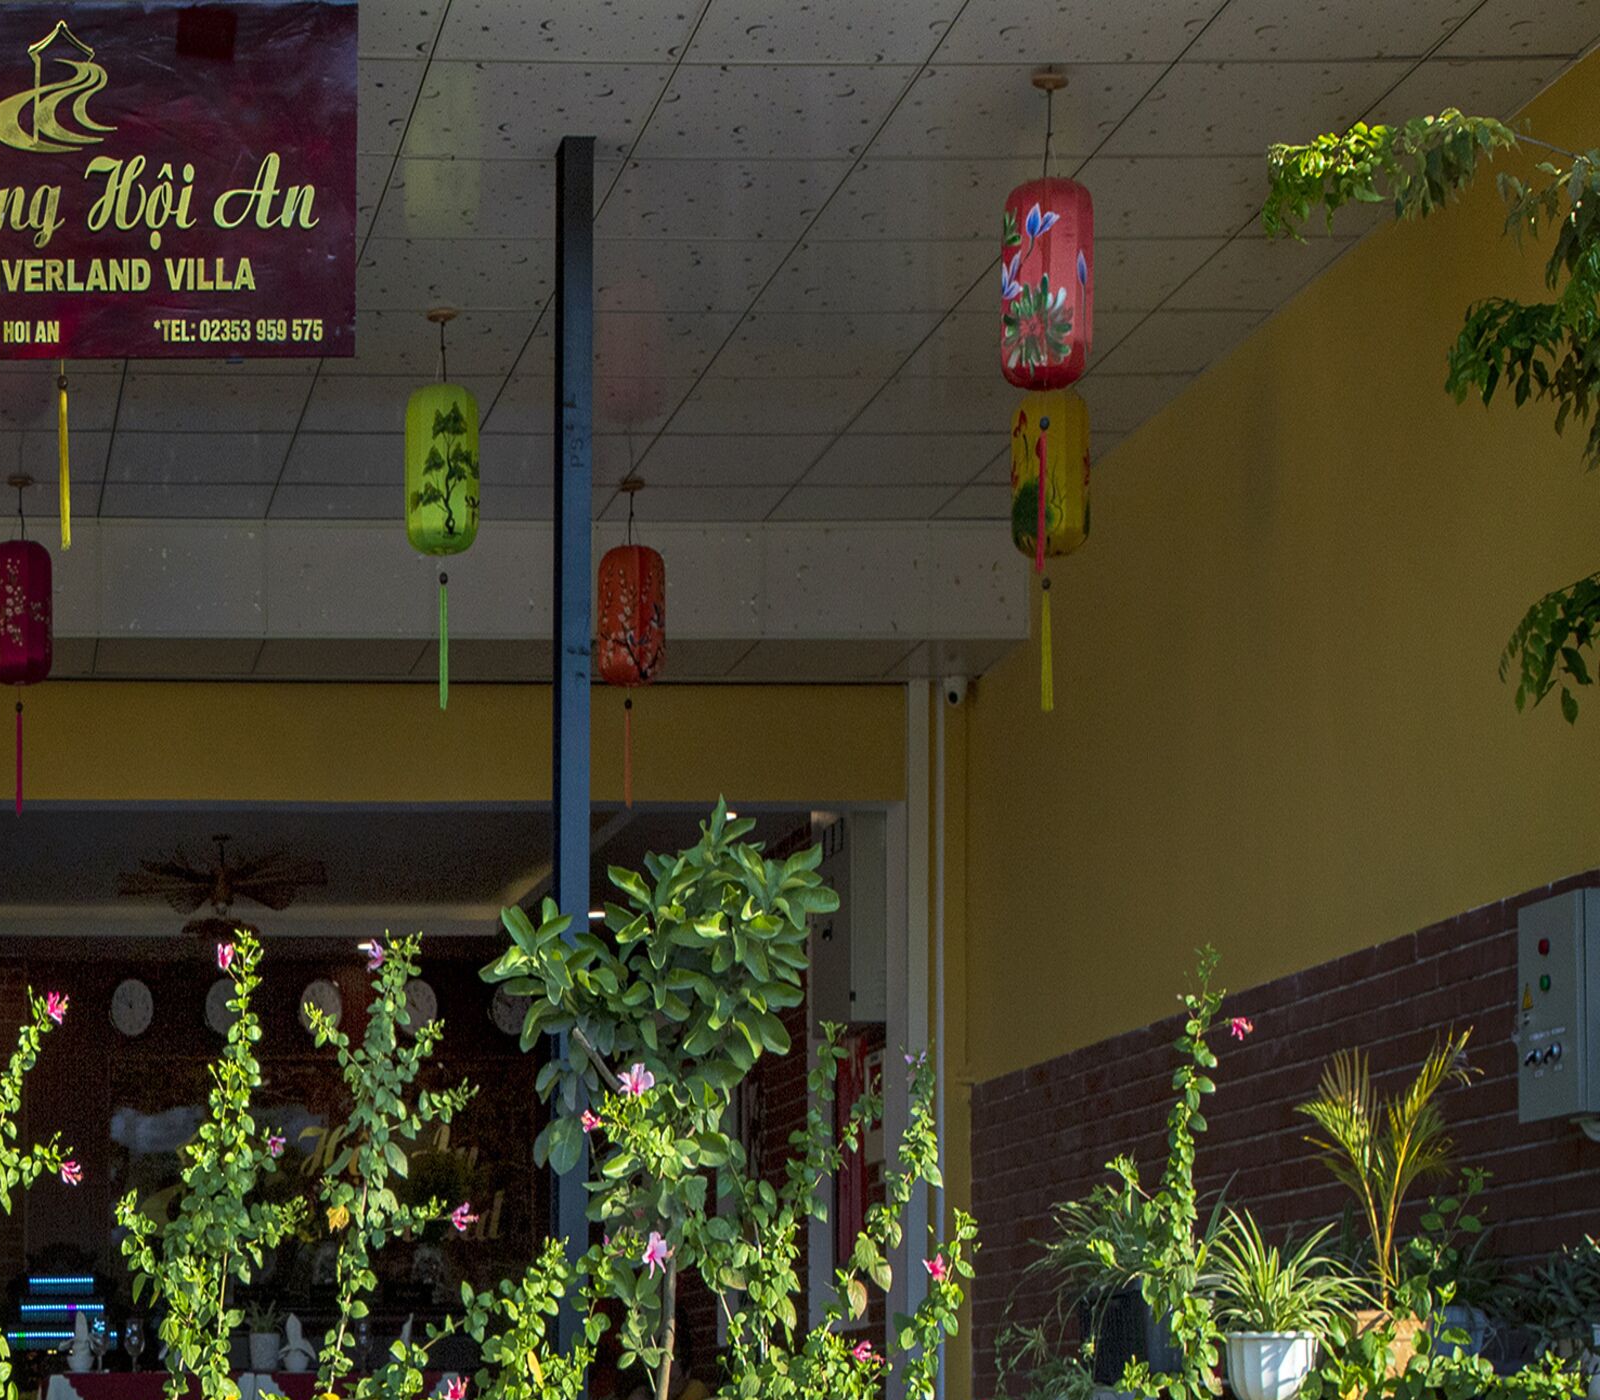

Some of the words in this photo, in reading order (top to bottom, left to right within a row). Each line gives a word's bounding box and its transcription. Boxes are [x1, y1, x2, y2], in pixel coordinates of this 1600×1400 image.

[85, 155, 197, 250] Hội
[213, 152, 320, 229] An
[164, 258, 256, 292] VILLA
[3, 321, 30, 344] HOI
[35, 321, 60, 344] AN
[200, 319, 251, 342] 02353
[256, 319, 287, 342] 959
[291, 319, 323, 342] 575
